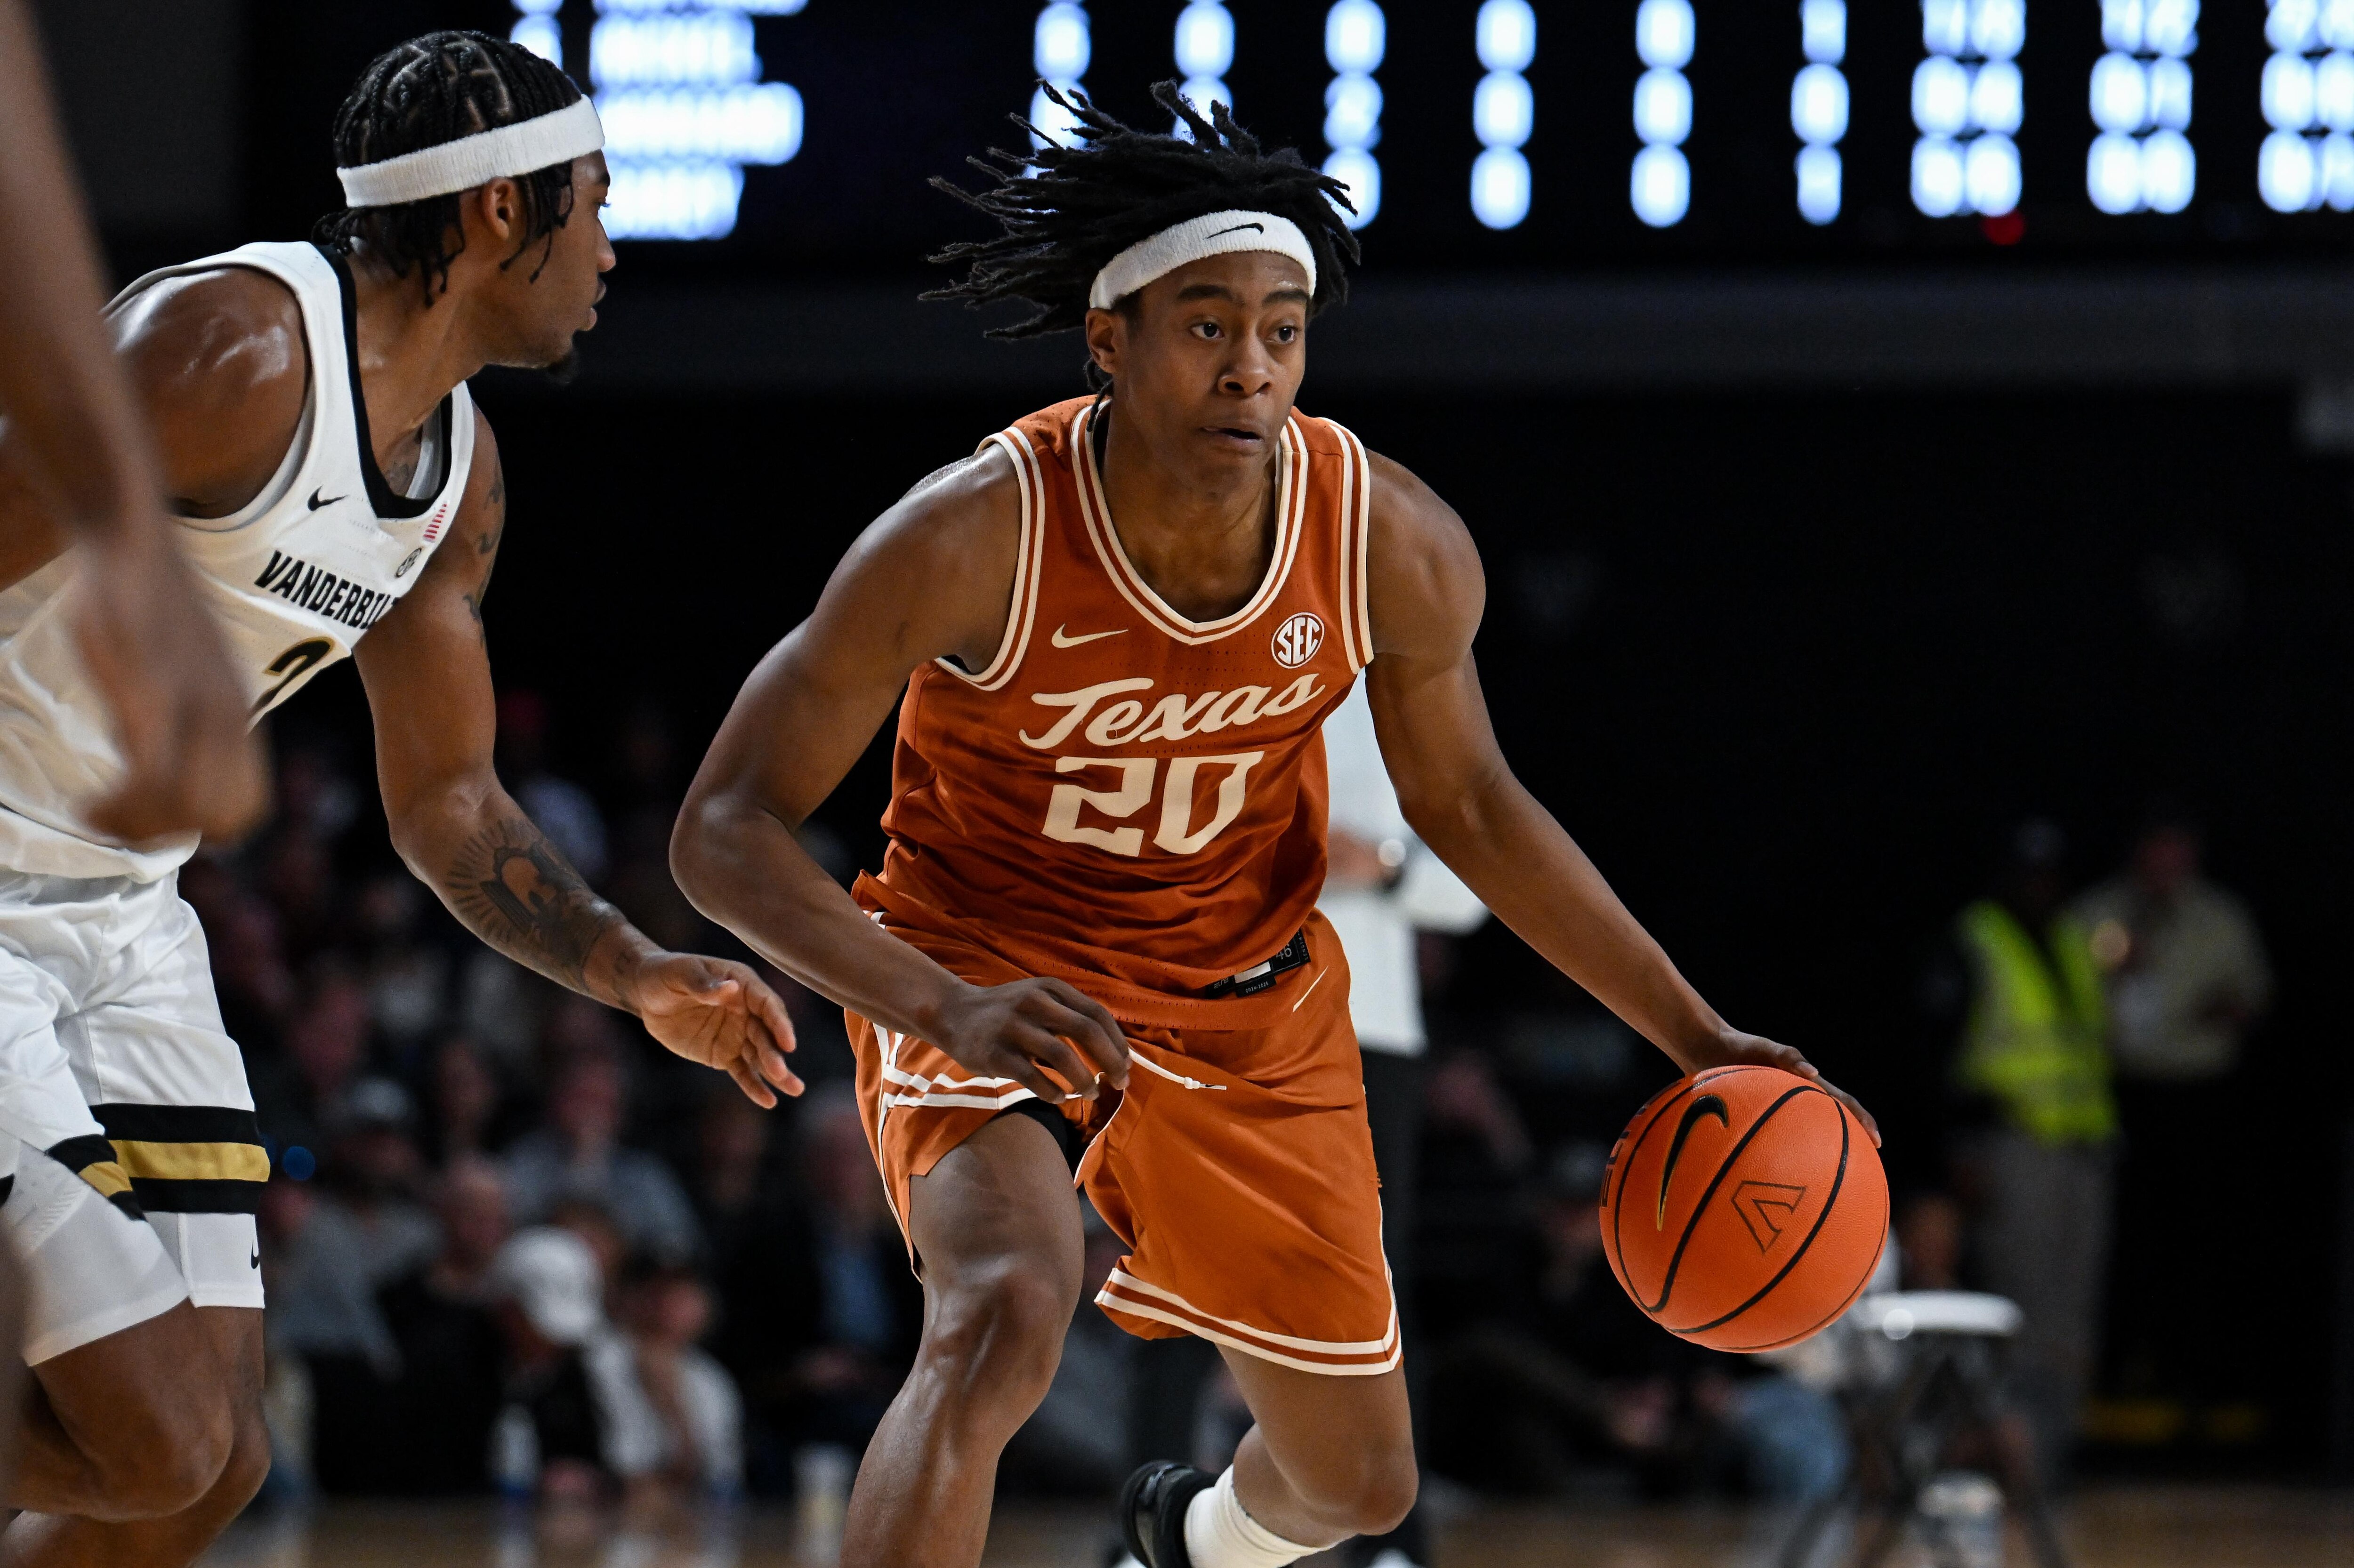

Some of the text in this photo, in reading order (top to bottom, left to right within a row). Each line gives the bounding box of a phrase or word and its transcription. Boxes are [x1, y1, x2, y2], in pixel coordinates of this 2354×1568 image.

[254, 550, 399, 630] VANDERBIL
[1276, 617, 1320, 665] SEC
[1019, 673, 1325, 749] Texas
[1041, 751, 1265, 857] 20
